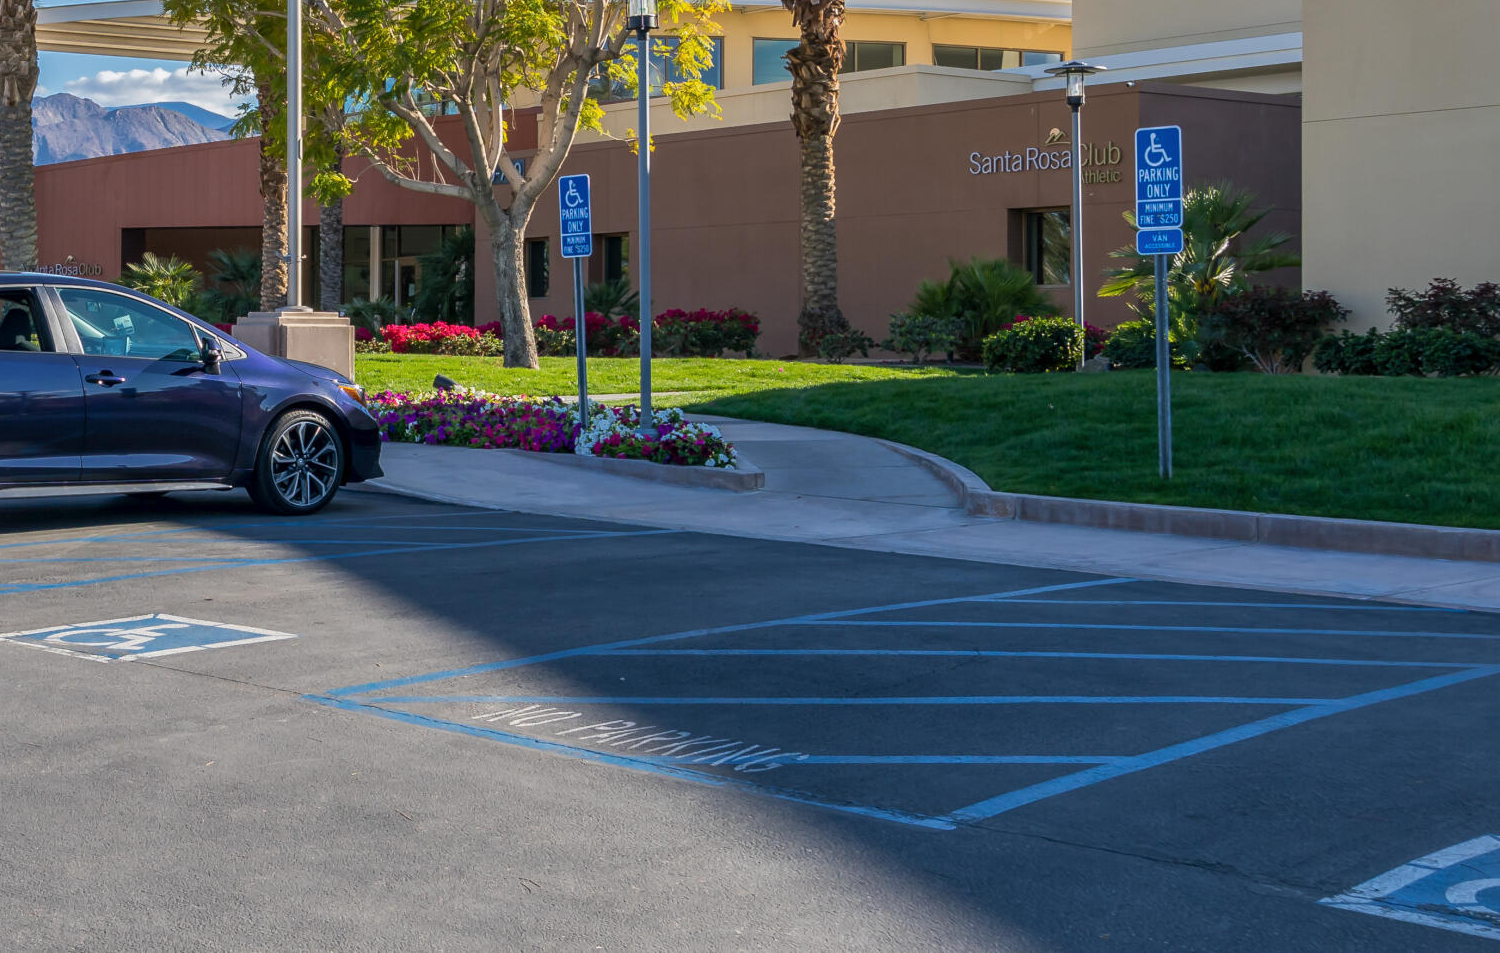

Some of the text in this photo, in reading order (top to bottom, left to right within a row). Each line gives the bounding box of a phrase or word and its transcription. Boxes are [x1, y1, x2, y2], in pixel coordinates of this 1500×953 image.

[969, 150, 1023, 175] Santa
[1026, 147, 1072, 171] Rosa
[1139, 167, 1179, 183] PARKING
[1147, 183, 1171, 198] ONLY
[562, 207, 589, 220] PARKING
[1145, 202, 1173, 213] MINIMUM
[1140, 214, 1179, 225] FINE $250
[567, 220, 583, 233] ONLY
[1152, 234, 1168, 242] VAN
[55, 264, 78, 276] Rosa
[472, 704, 810, 773] NO PARKING
